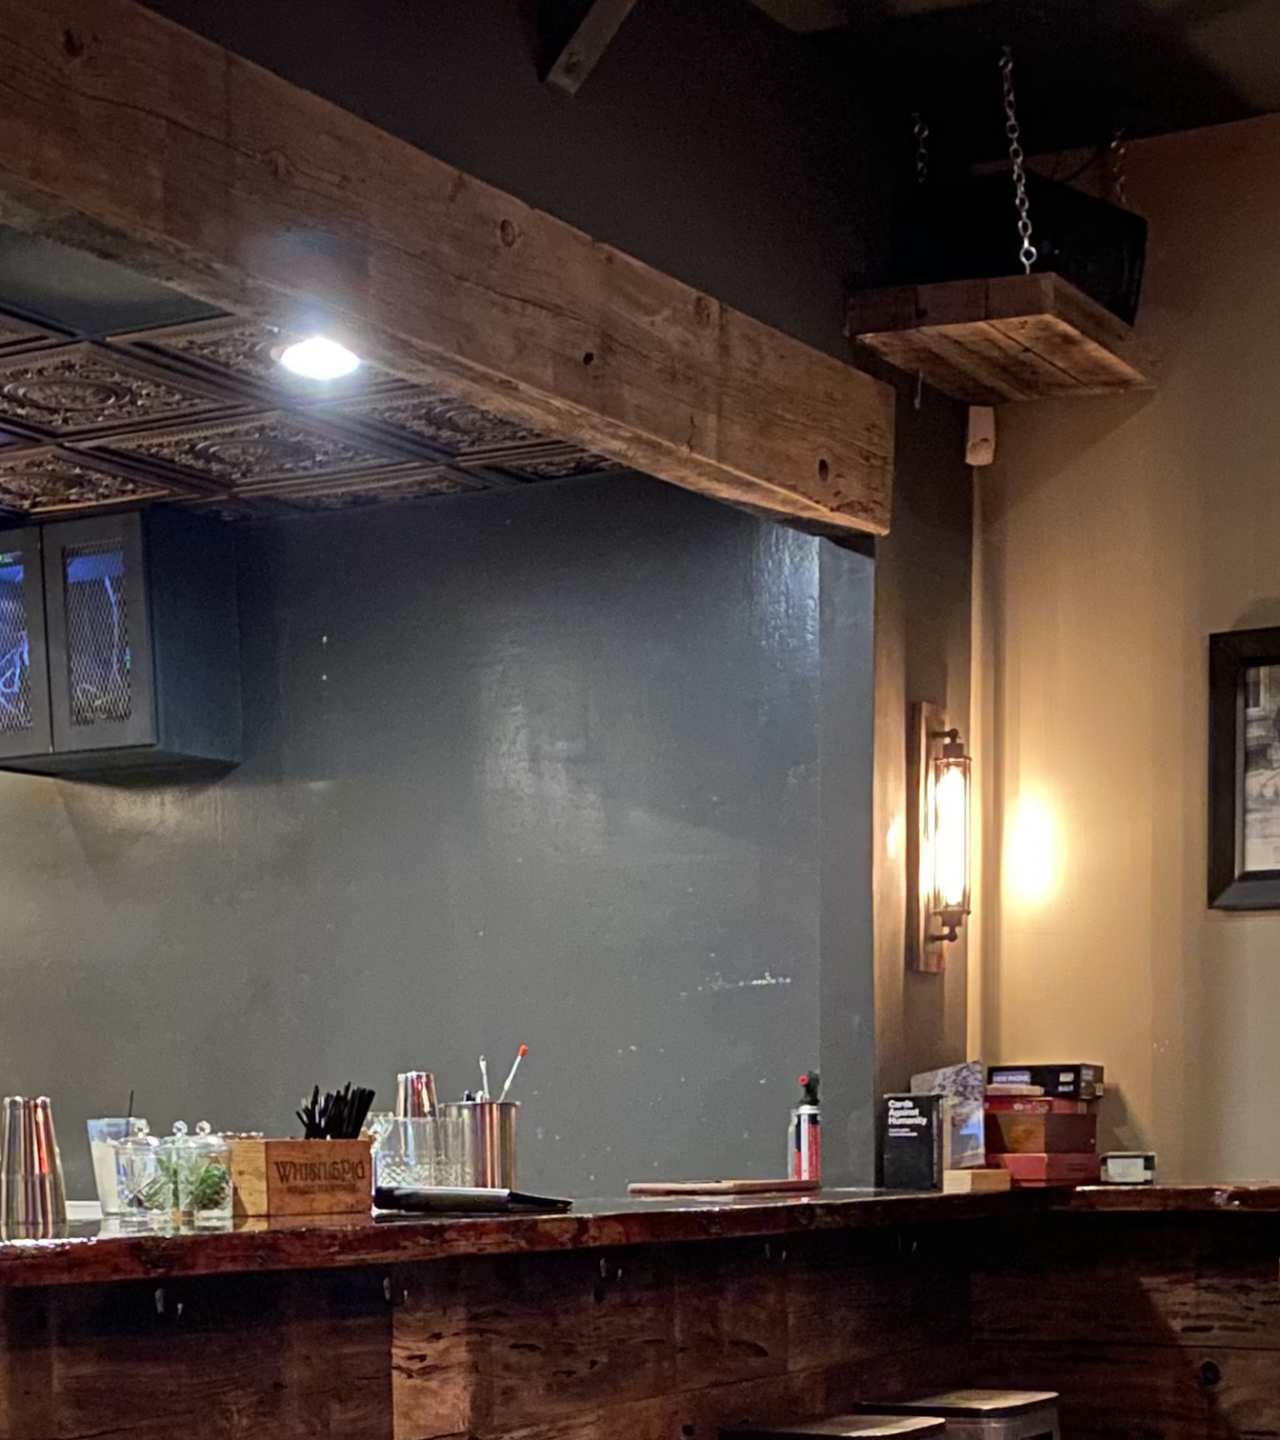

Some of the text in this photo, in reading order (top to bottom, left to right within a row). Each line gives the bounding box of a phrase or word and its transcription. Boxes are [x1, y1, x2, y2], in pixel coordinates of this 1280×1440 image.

[888, 1099, 913, 1108] Cards
[888, 1108, 919, 1117] Against
[888, 1116, 927, 1126] Humanity
